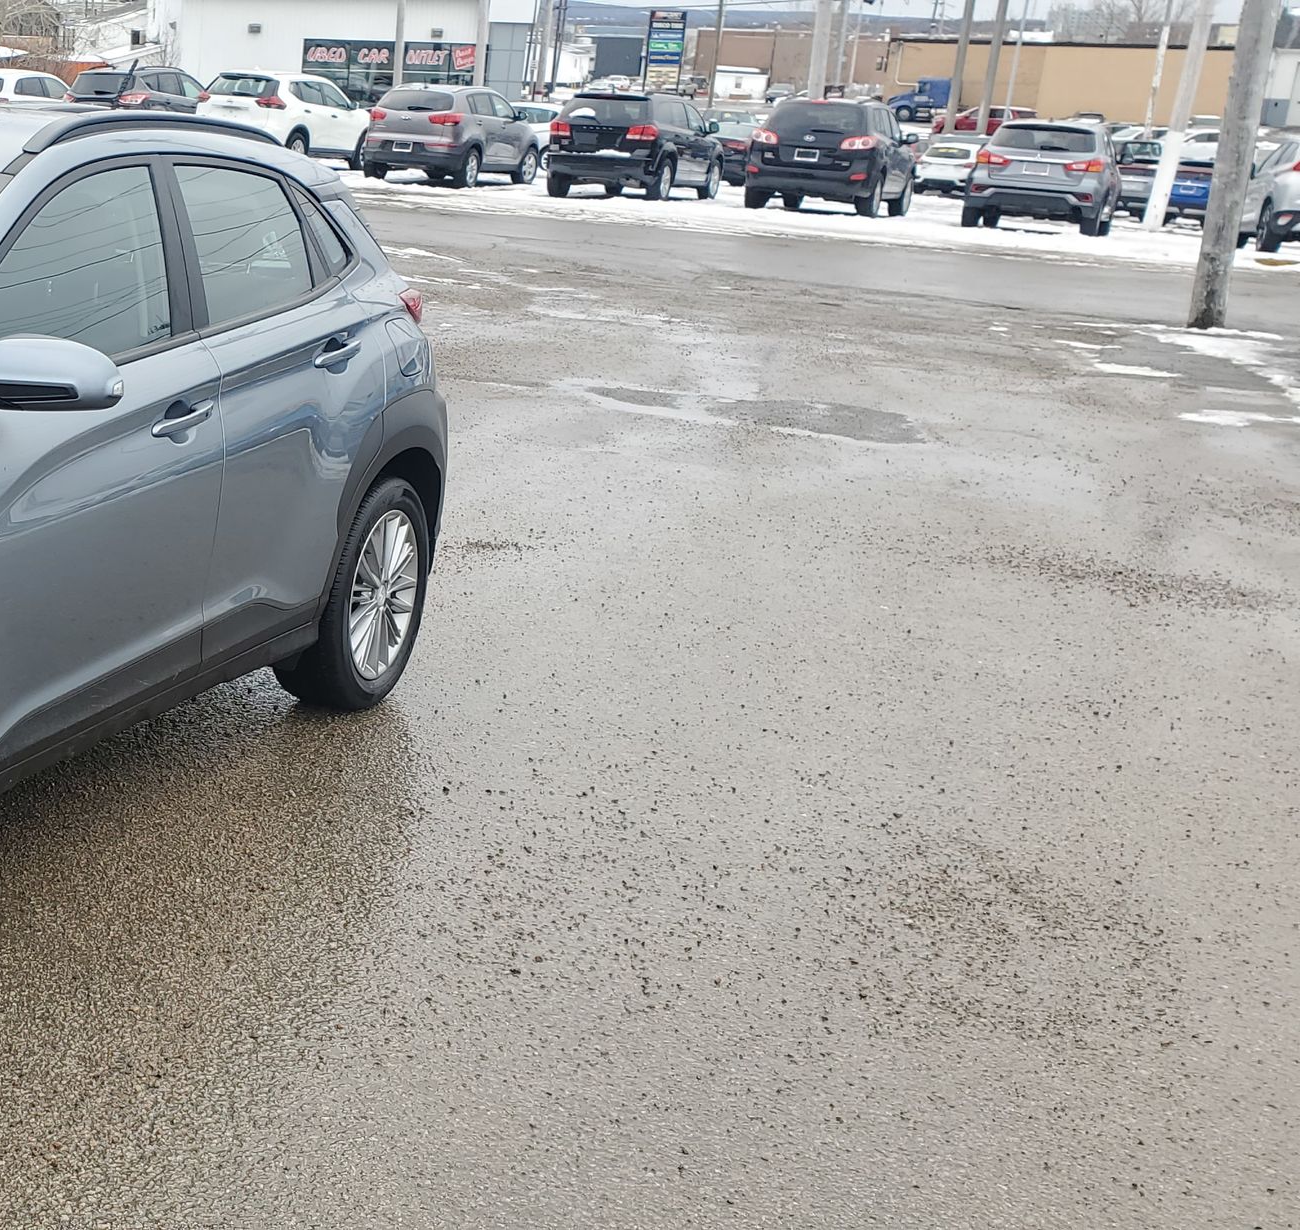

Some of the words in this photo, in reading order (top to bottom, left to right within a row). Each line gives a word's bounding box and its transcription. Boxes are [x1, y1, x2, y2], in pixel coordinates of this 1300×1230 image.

[306, 46, 348, 63] USED
[357, 47, 390, 64] CAR
[405, 49, 450, 65] OUTLET
